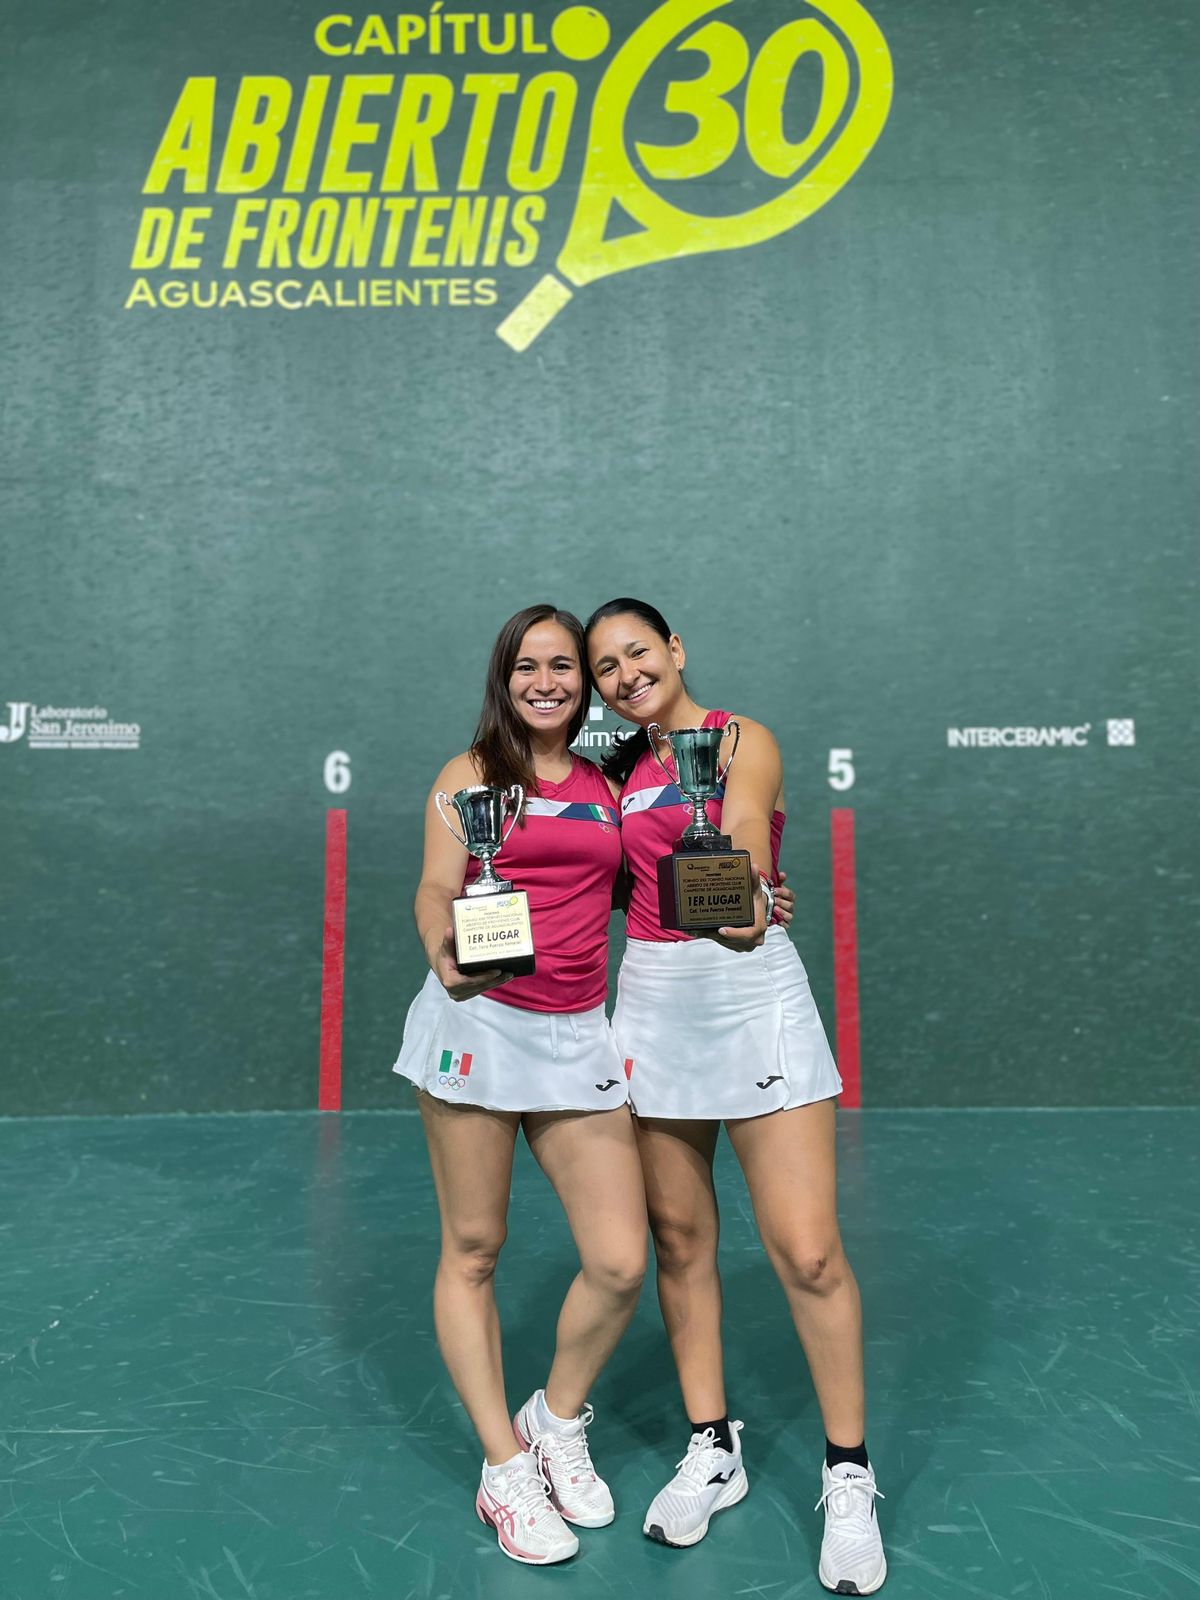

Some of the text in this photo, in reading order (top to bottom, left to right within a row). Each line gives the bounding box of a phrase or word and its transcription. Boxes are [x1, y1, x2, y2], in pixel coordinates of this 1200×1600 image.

[633, 18, 850, 180] 30
[141, 70, 579, 194] ABIERTO
[130, 194, 547, 270] DE FRONTENIS
[123, 276, 498, 310] AGUASCALIENTES
[30, 719, 61, 736] San
[31, 704, 108, 719] Laboratorio
[323, 750, 351, 793] 6
[828, 748, 856, 791] 5
[688, 894, 741, 907] 1ER LUGAR
[467, 929, 520, 944] 1ER LUGAR
